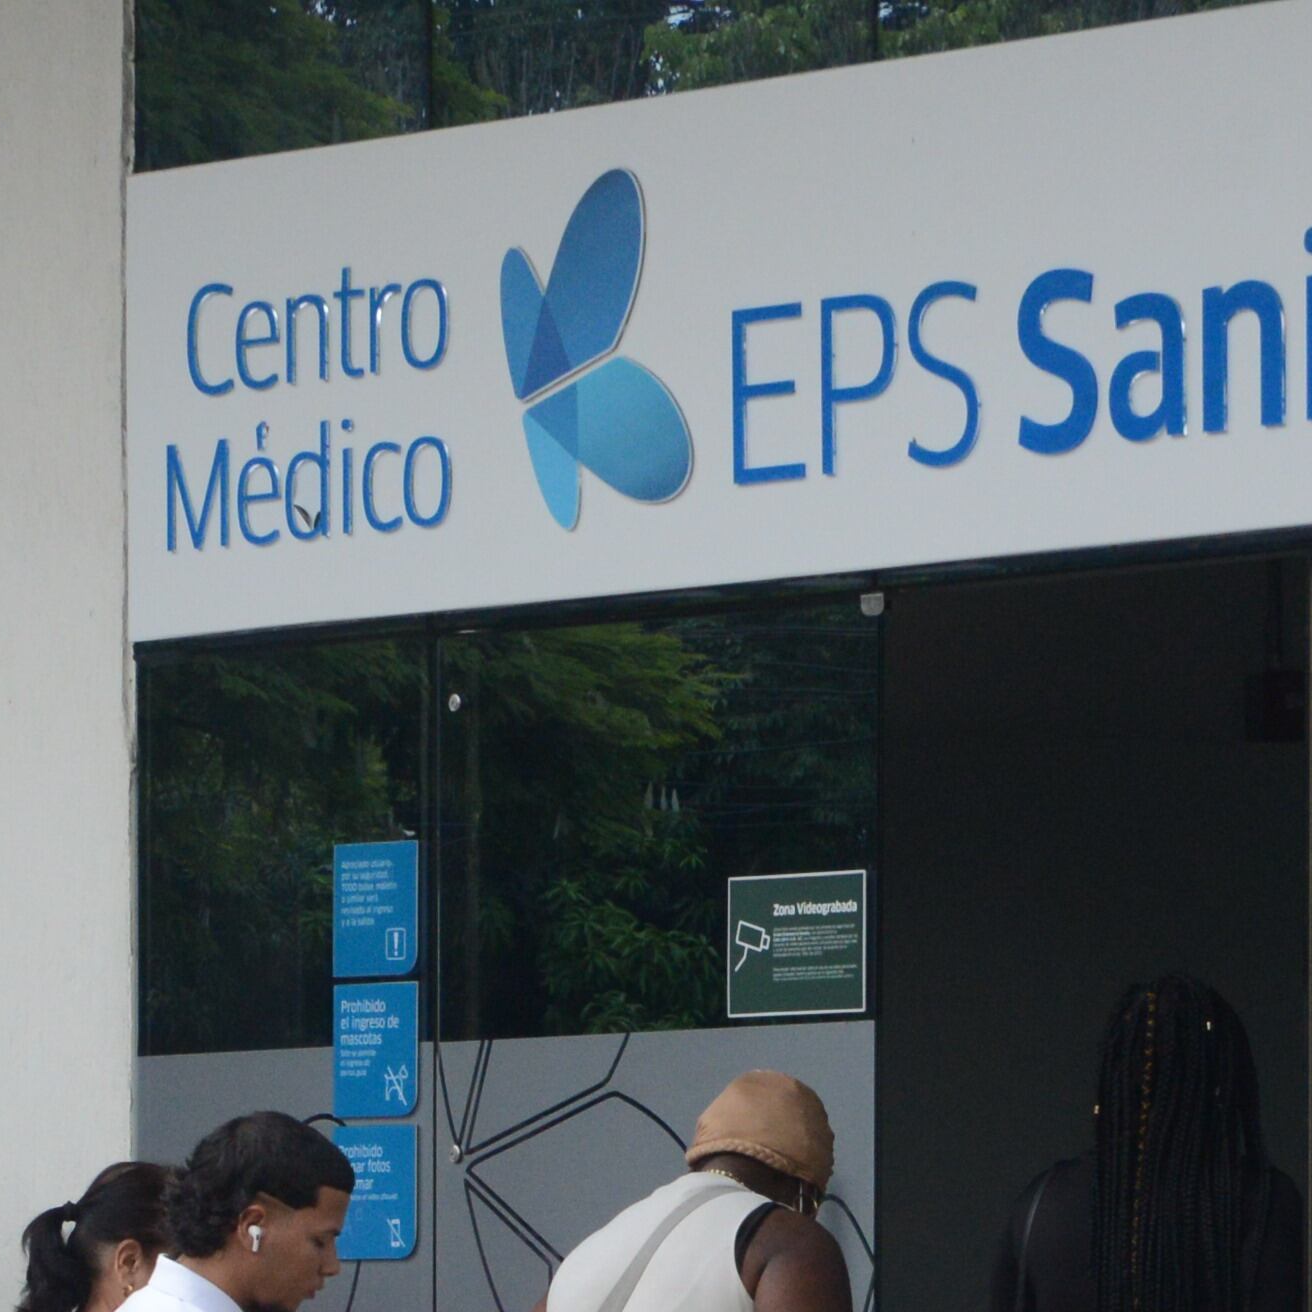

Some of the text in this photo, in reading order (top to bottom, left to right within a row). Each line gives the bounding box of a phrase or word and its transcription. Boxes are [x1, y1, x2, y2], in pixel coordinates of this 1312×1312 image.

[187, 266, 451, 397] Centro
[730, 280, 983, 487] EPS
[165, 419, 454, 553] Médico
[773, 899, 858, 917] Zona Videograbada
[340, 999, 386, 1013] Prohibido
[340, 1015, 400, 1031] el ingreso de
[340, 1031, 383, 1045] mascotas
[368, 1159, 391, 1173] fotos
